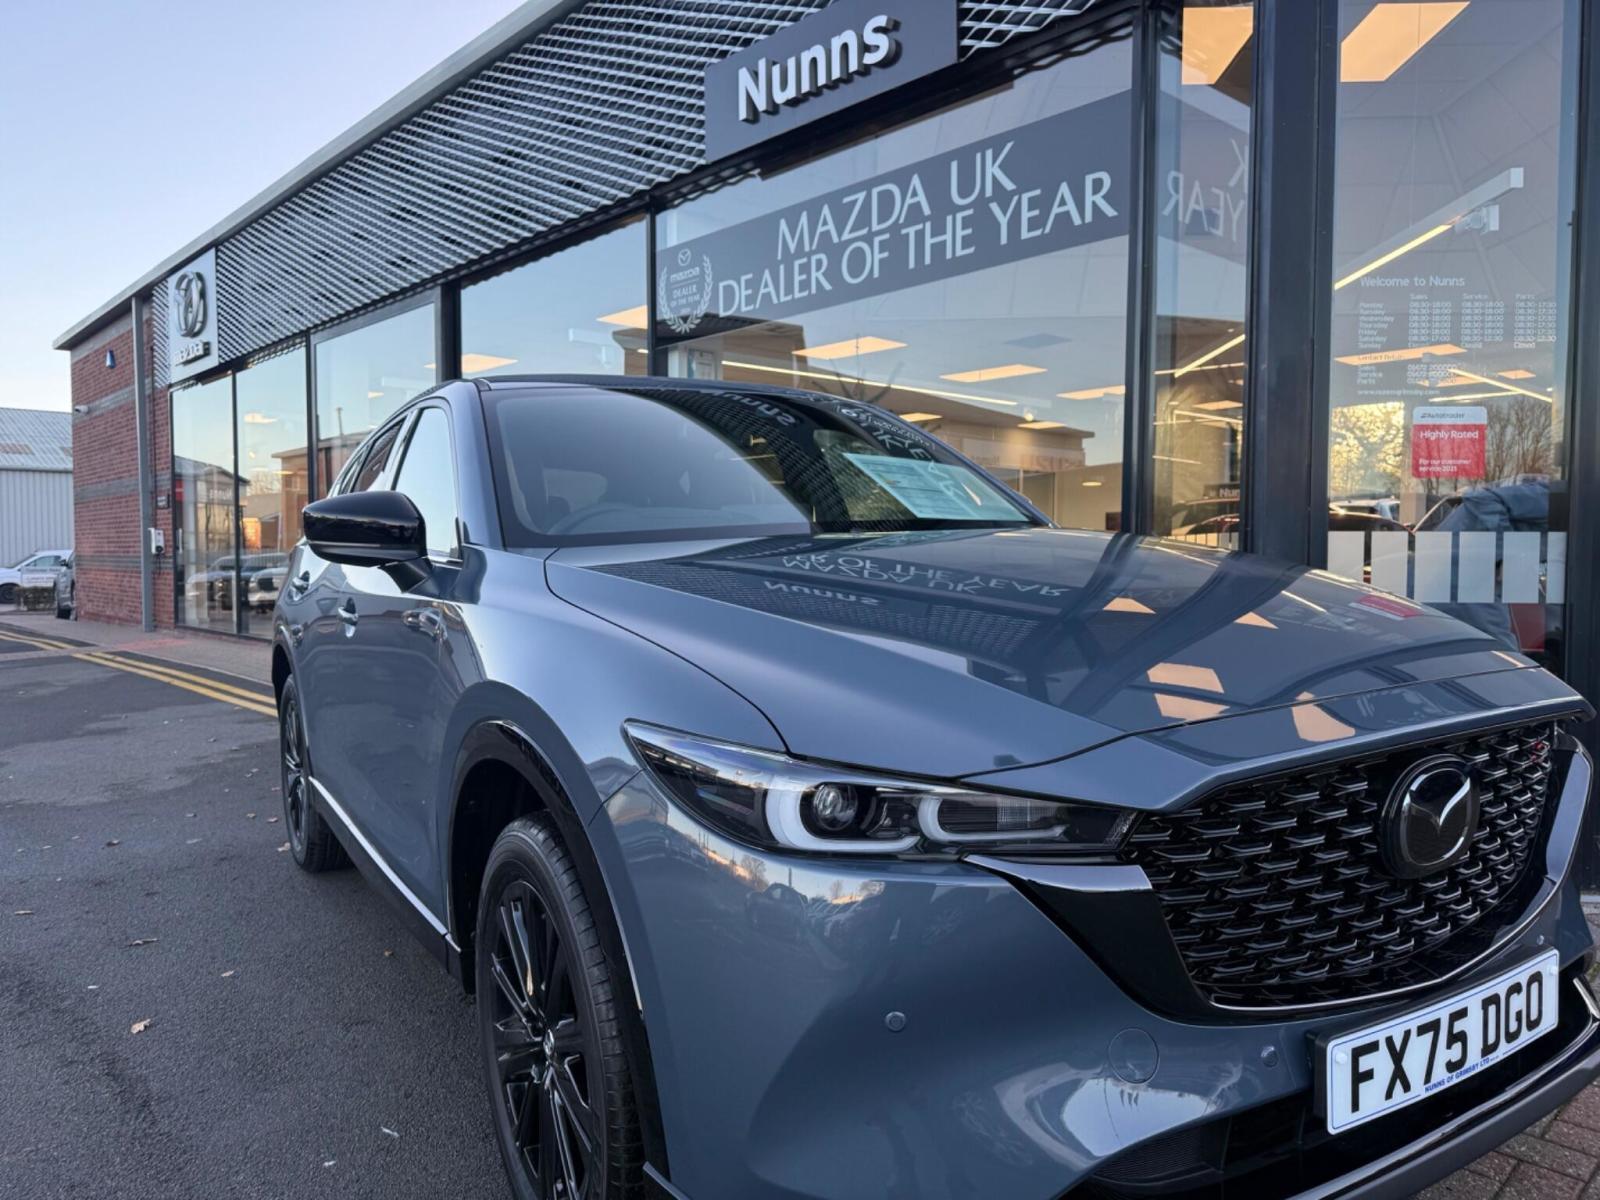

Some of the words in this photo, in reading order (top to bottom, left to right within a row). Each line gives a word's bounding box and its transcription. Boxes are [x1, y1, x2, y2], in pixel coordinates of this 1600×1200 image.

[737, 14, 895, 122] Nunns
[719, 254, 832, 318] DEALER
[841, 233, 889, 284] OF
[901, 208, 976, 269] THE
[989, 170, 1119, 242] YEAR
[777, 173, 931, 261] MAZDA
[950, 140, 1017, 199] UK
[1360, 276, 1410, 287] Welcome
[1414, 277, 1426, 287] to
[1429, 275, 1465, 287] Nunns
[1420, 429, 1449, 441] Highly
[1451, 430, 1479, 439] Rated
[1351, 1007, 1469, 1113] FX75
[1481, 970, 1543, 1059] DGO
[1455, 1063, 1479, 1078] GRIMSBY
